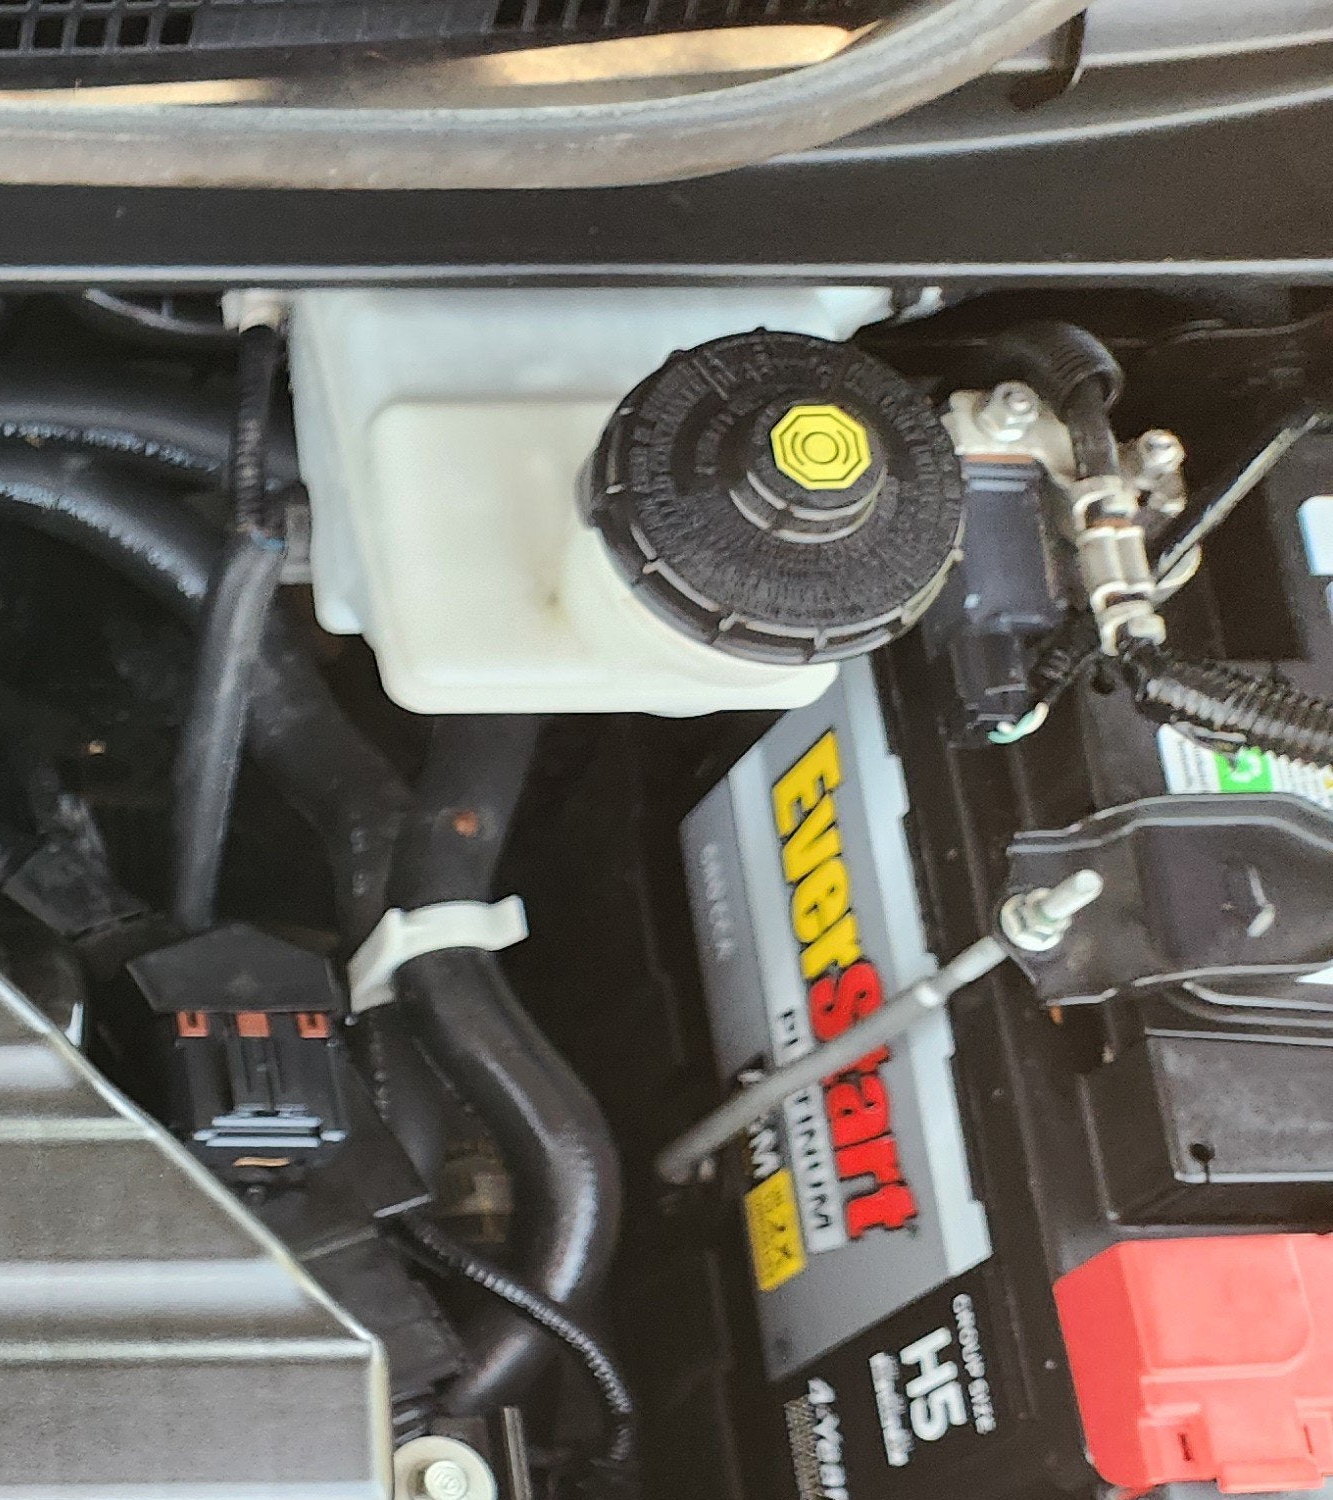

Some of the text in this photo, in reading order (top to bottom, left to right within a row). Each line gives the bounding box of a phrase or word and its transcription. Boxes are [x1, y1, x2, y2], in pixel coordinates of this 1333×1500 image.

[779, 1007, 834, 1231] PLTINUM
[899, 1326, 968, 1441] H5
[952, 1293, 985, 1378] GROUP
